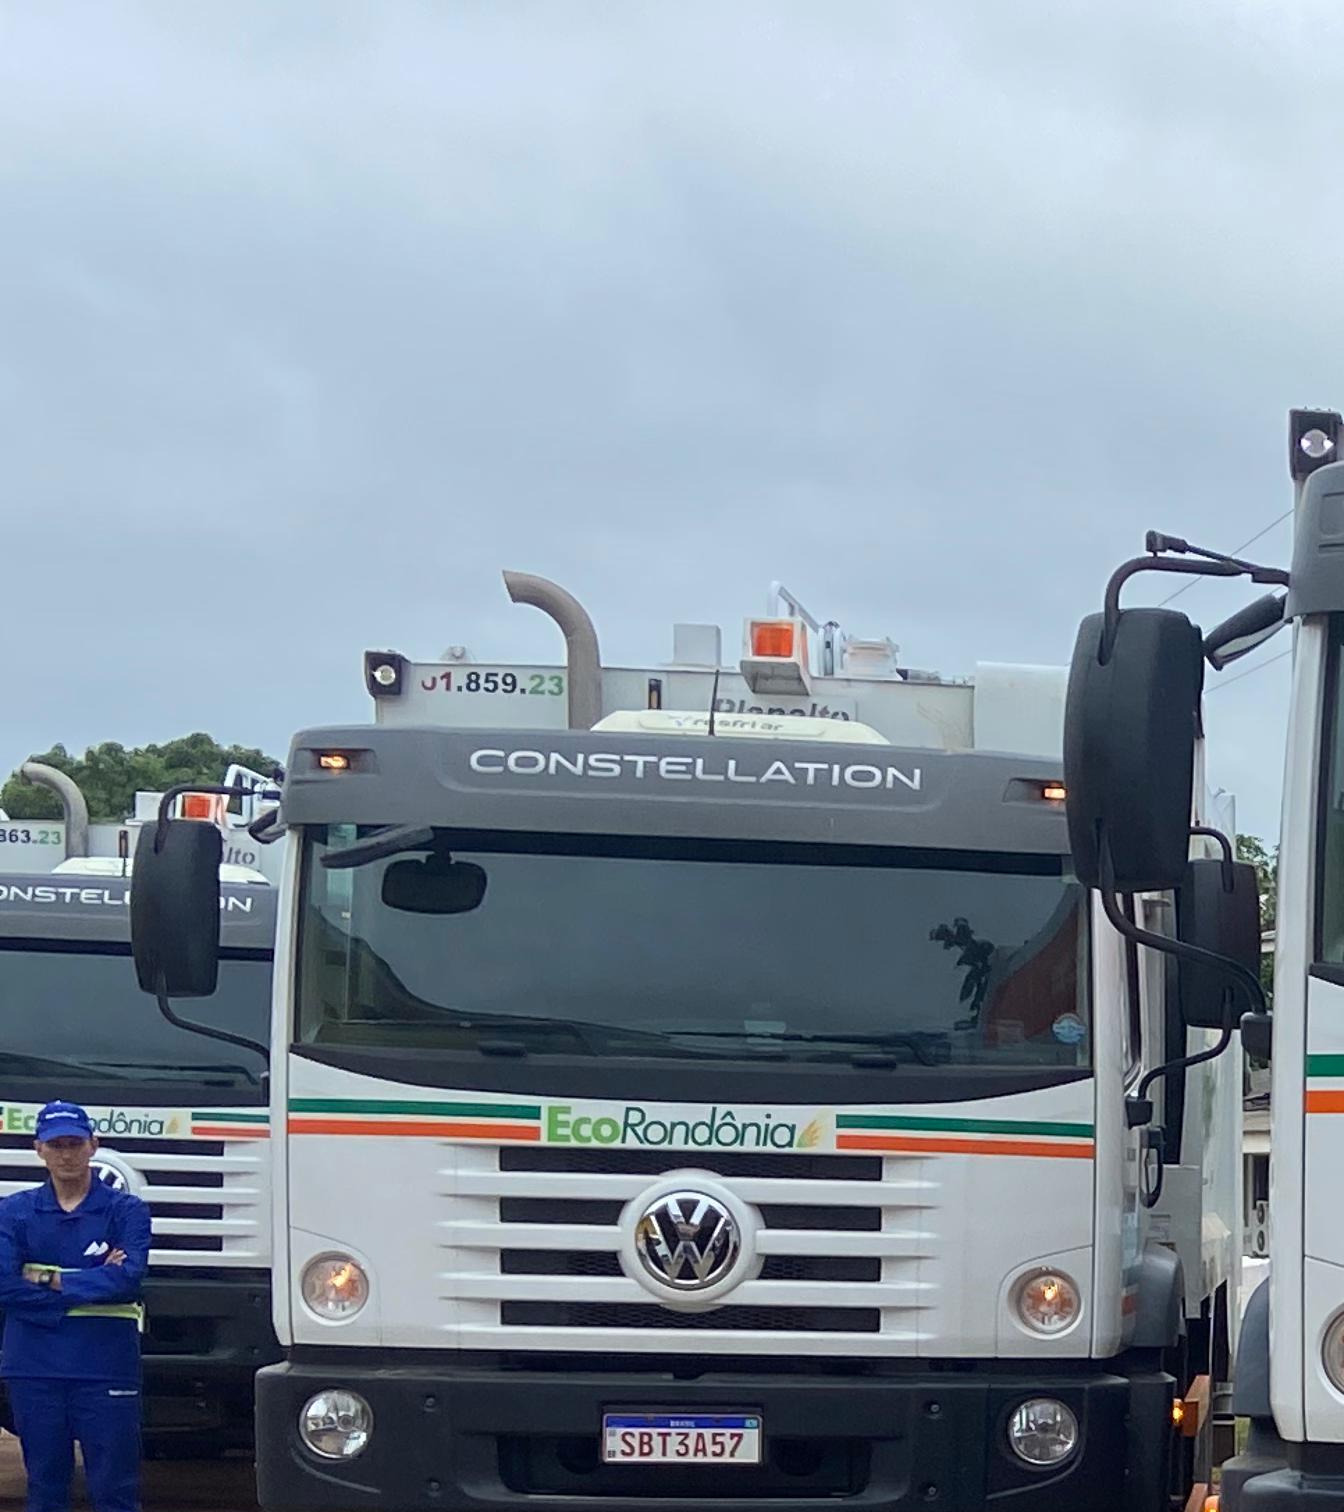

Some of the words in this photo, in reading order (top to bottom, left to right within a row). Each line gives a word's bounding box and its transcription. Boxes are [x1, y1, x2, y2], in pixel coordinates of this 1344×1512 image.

[469, 748, 922, 791] CONSTELLATION
[547, 1106, 797, 1148] EcoRondônia
[620, 1431, 744, 1458] SBT3A57
